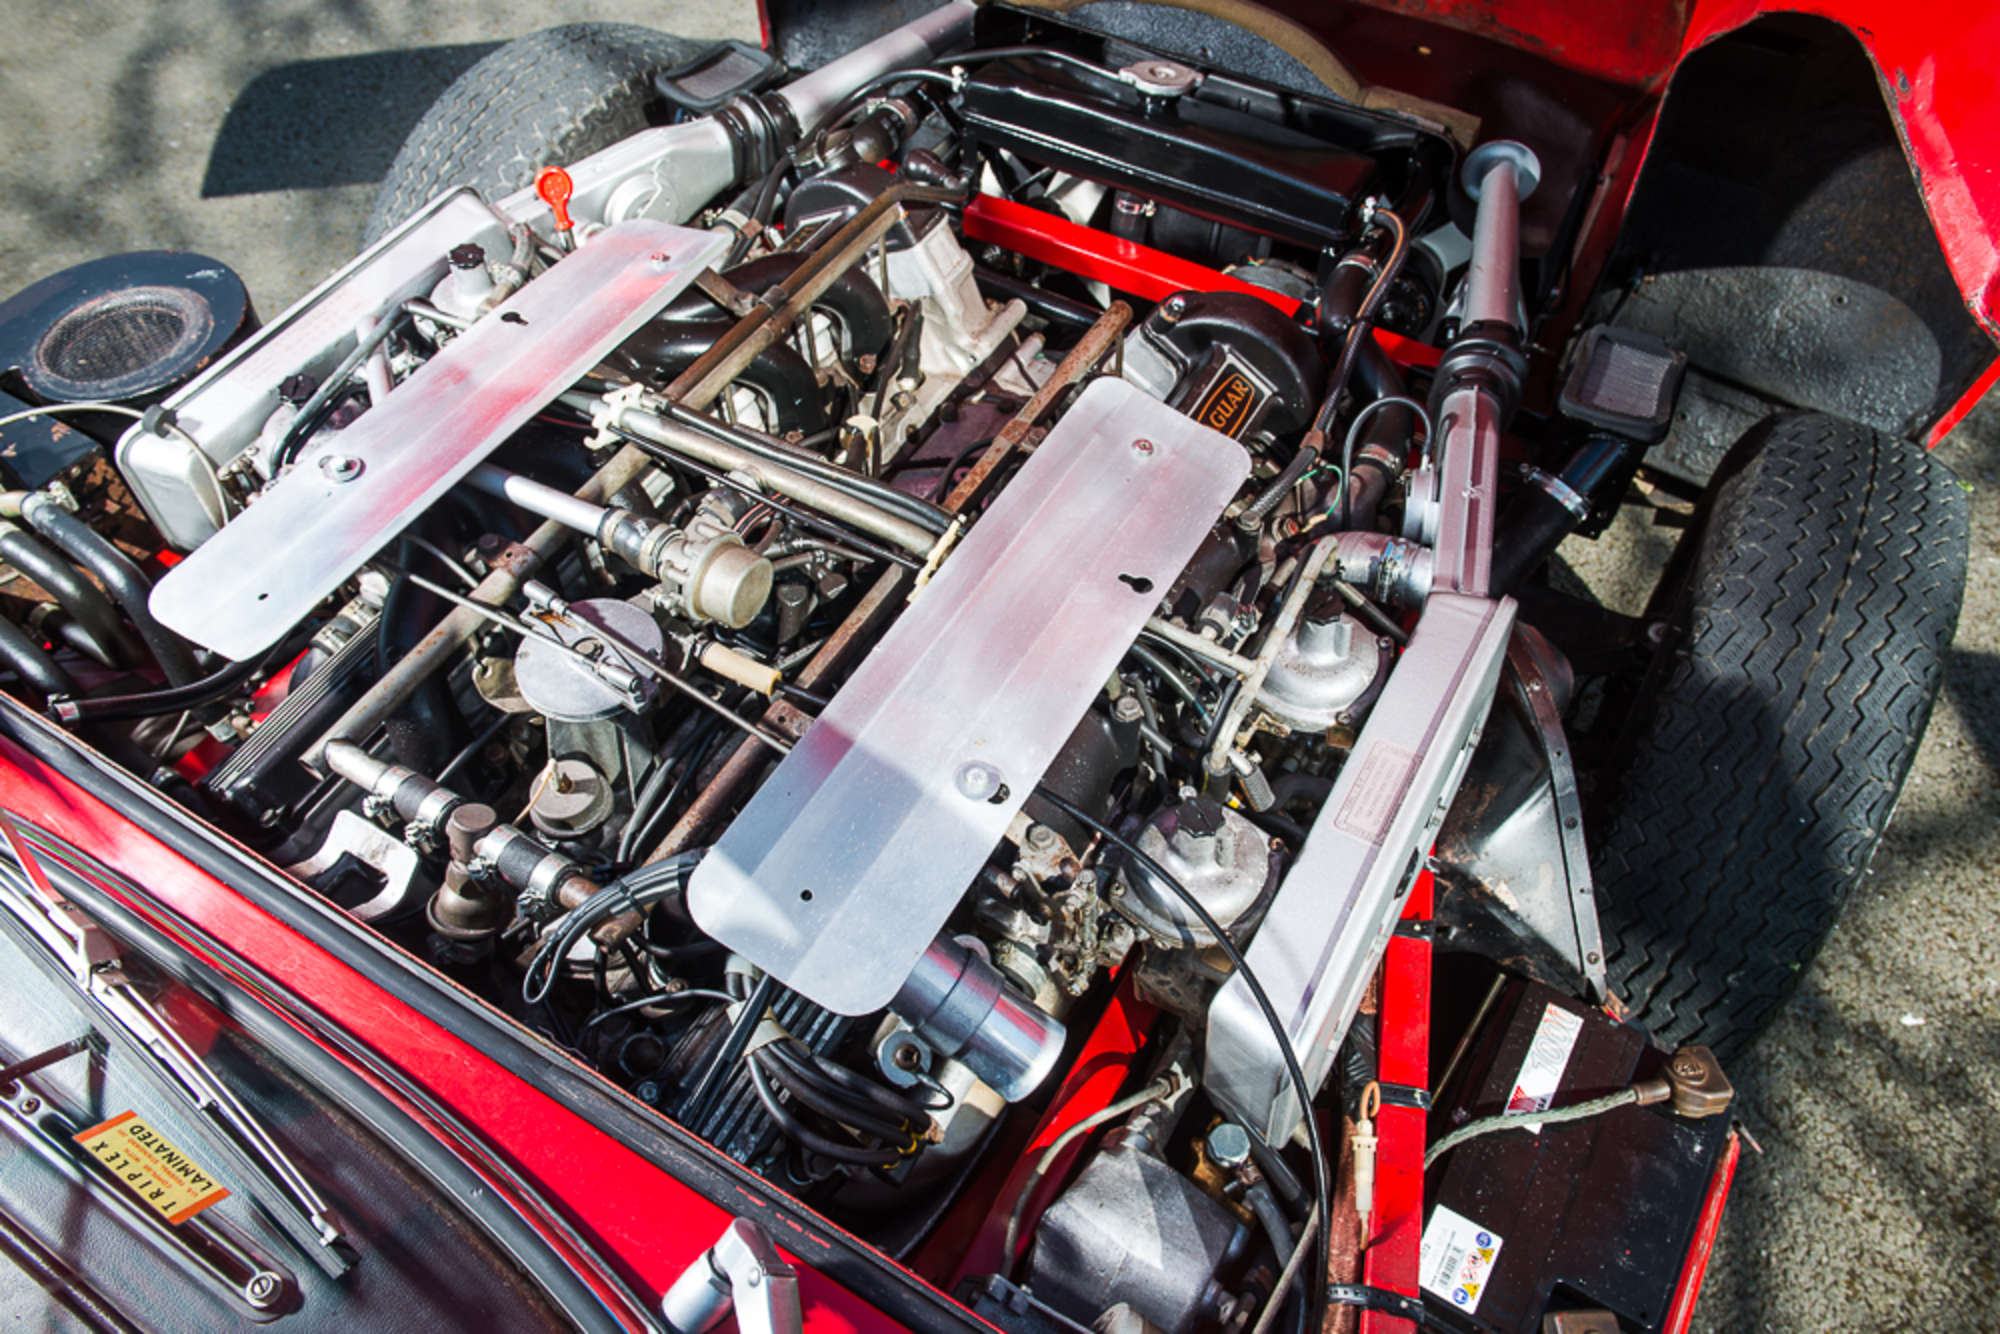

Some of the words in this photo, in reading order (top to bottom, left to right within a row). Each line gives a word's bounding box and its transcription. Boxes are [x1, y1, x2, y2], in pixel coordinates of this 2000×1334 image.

[1209, 379, 1249, 428] GUAR
[91, 1141, 177, 1212] TRIPLEX
[129, 1124, 213, 1192] LAMINATED
